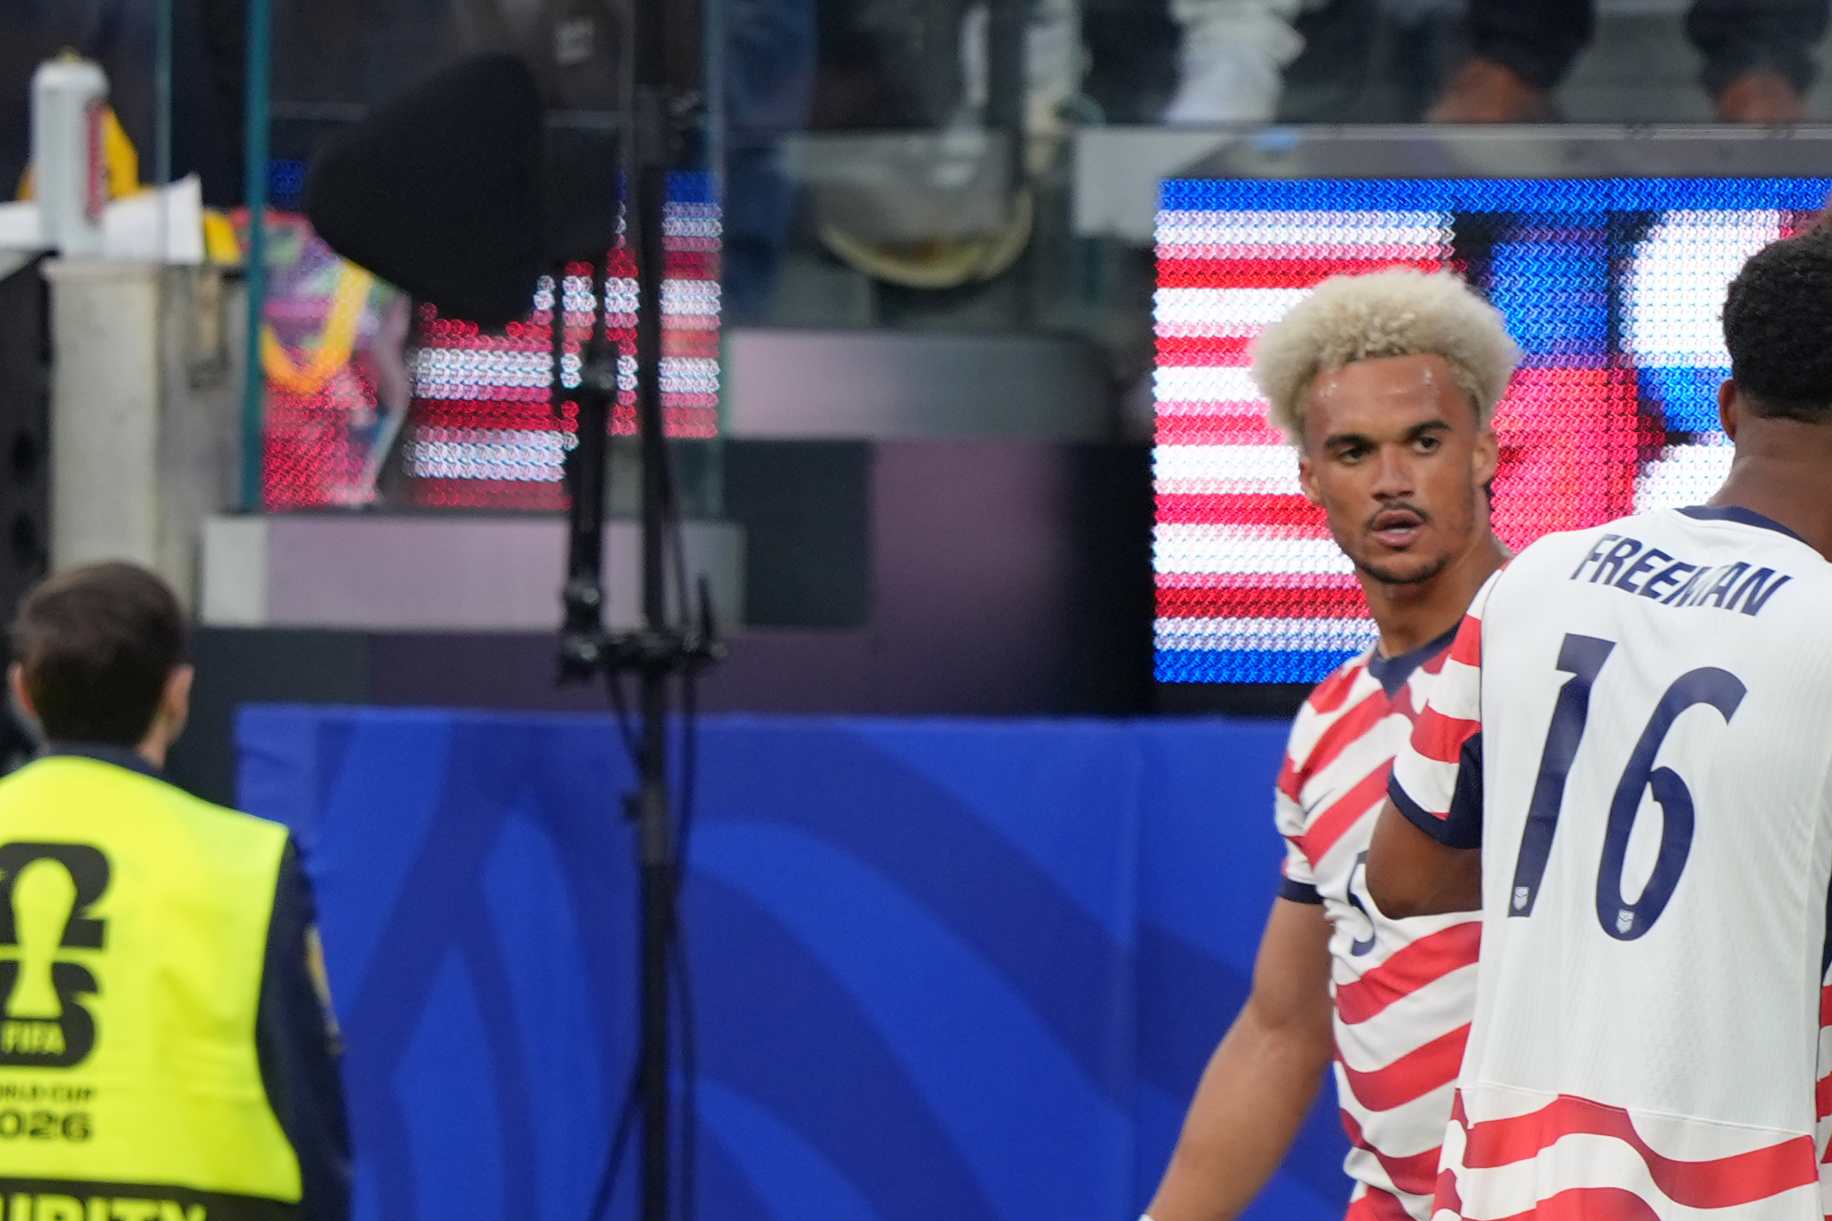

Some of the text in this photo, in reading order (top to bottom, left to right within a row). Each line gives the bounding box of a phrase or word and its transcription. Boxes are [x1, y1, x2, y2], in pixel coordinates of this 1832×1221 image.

[1570, 533, 1791, 617] FREEMAN
[1508, 633, 1748, 942] 16
[0, 1110, 91, 1141] 026
